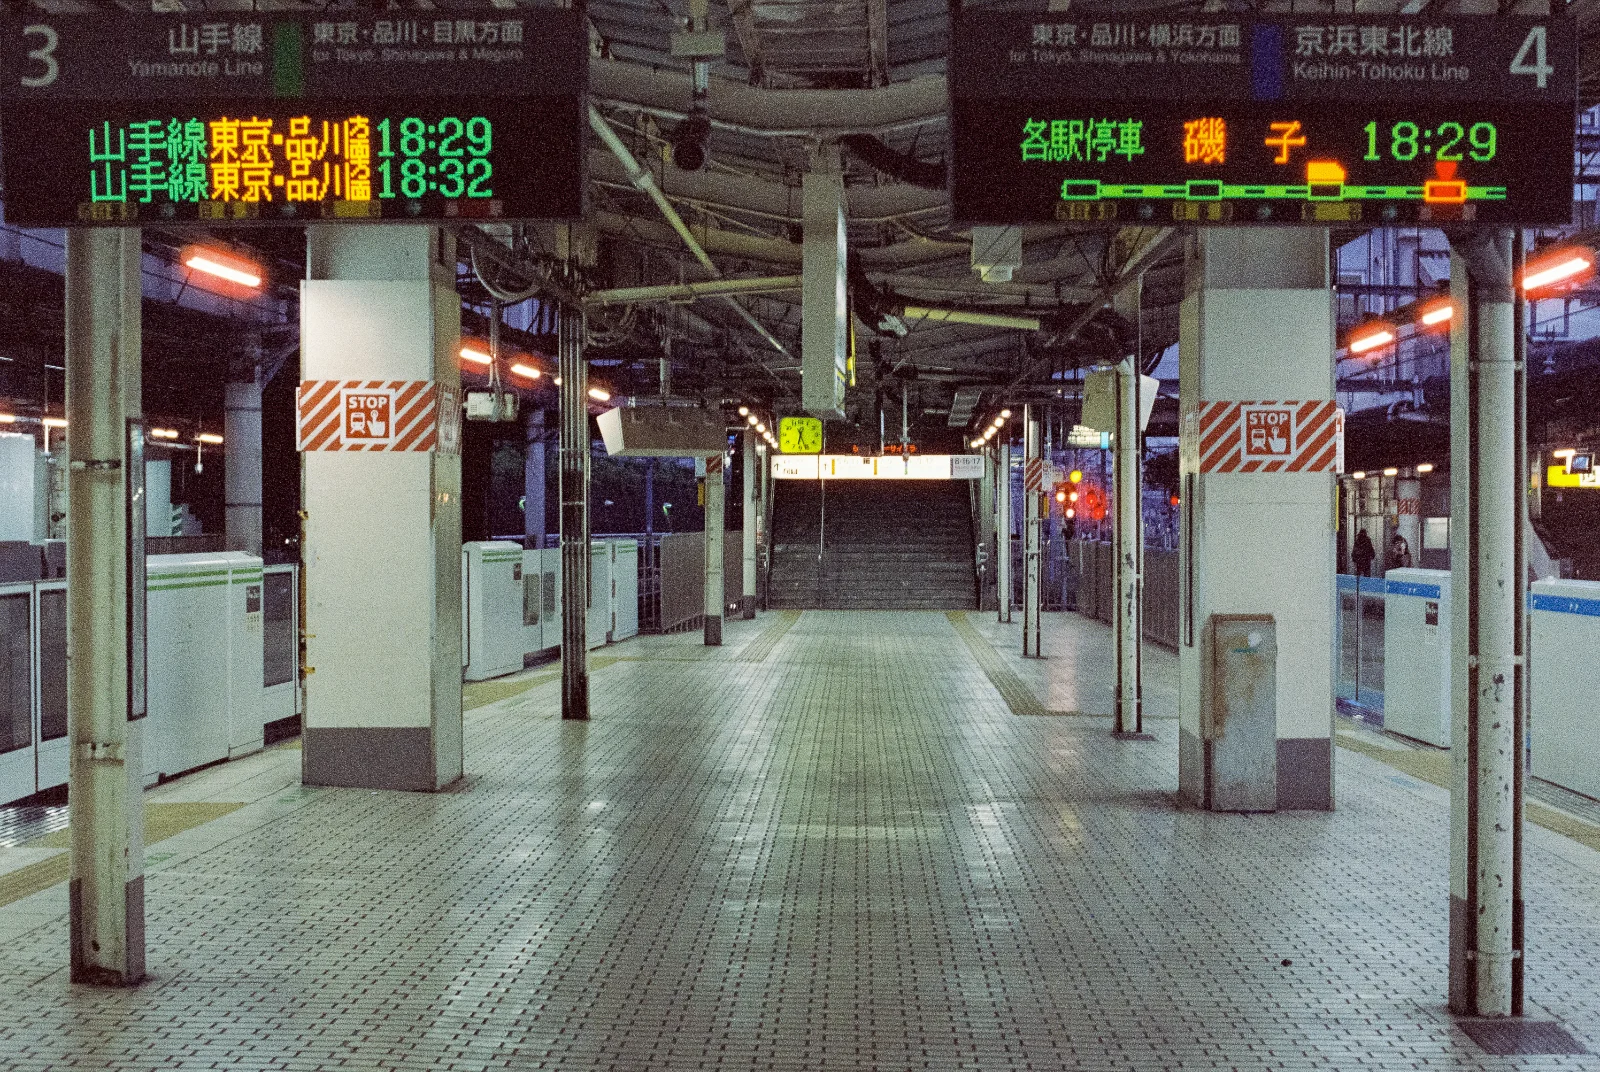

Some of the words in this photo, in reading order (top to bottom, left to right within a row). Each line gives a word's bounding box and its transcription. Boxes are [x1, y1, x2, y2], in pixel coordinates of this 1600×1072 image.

[168, 23, 263, 54] 山手線
[1294, 25, 1454, 57] 京浜東北線
[21, 24, 59, 87] 3
[129, 60, 220, 77] Yamanote
[224, 58, 264, 76] Line
[1431, 61, 1470, 81] Line
[1508, 25, 1554, 89] 4
[89, 117, 208, 162] 山手線
[376, 116, 493, 157] 18:29
[1020, 117, 1145, 162] 各駅停車
[1363, 121, 1497, 161] 18:29
[91, 159, 209, 203] 山手線
[377, 158, 494, 199] 18:32
[348, 396, 388, 410] STOP
[1249, 412, 1289, 426] STOP
